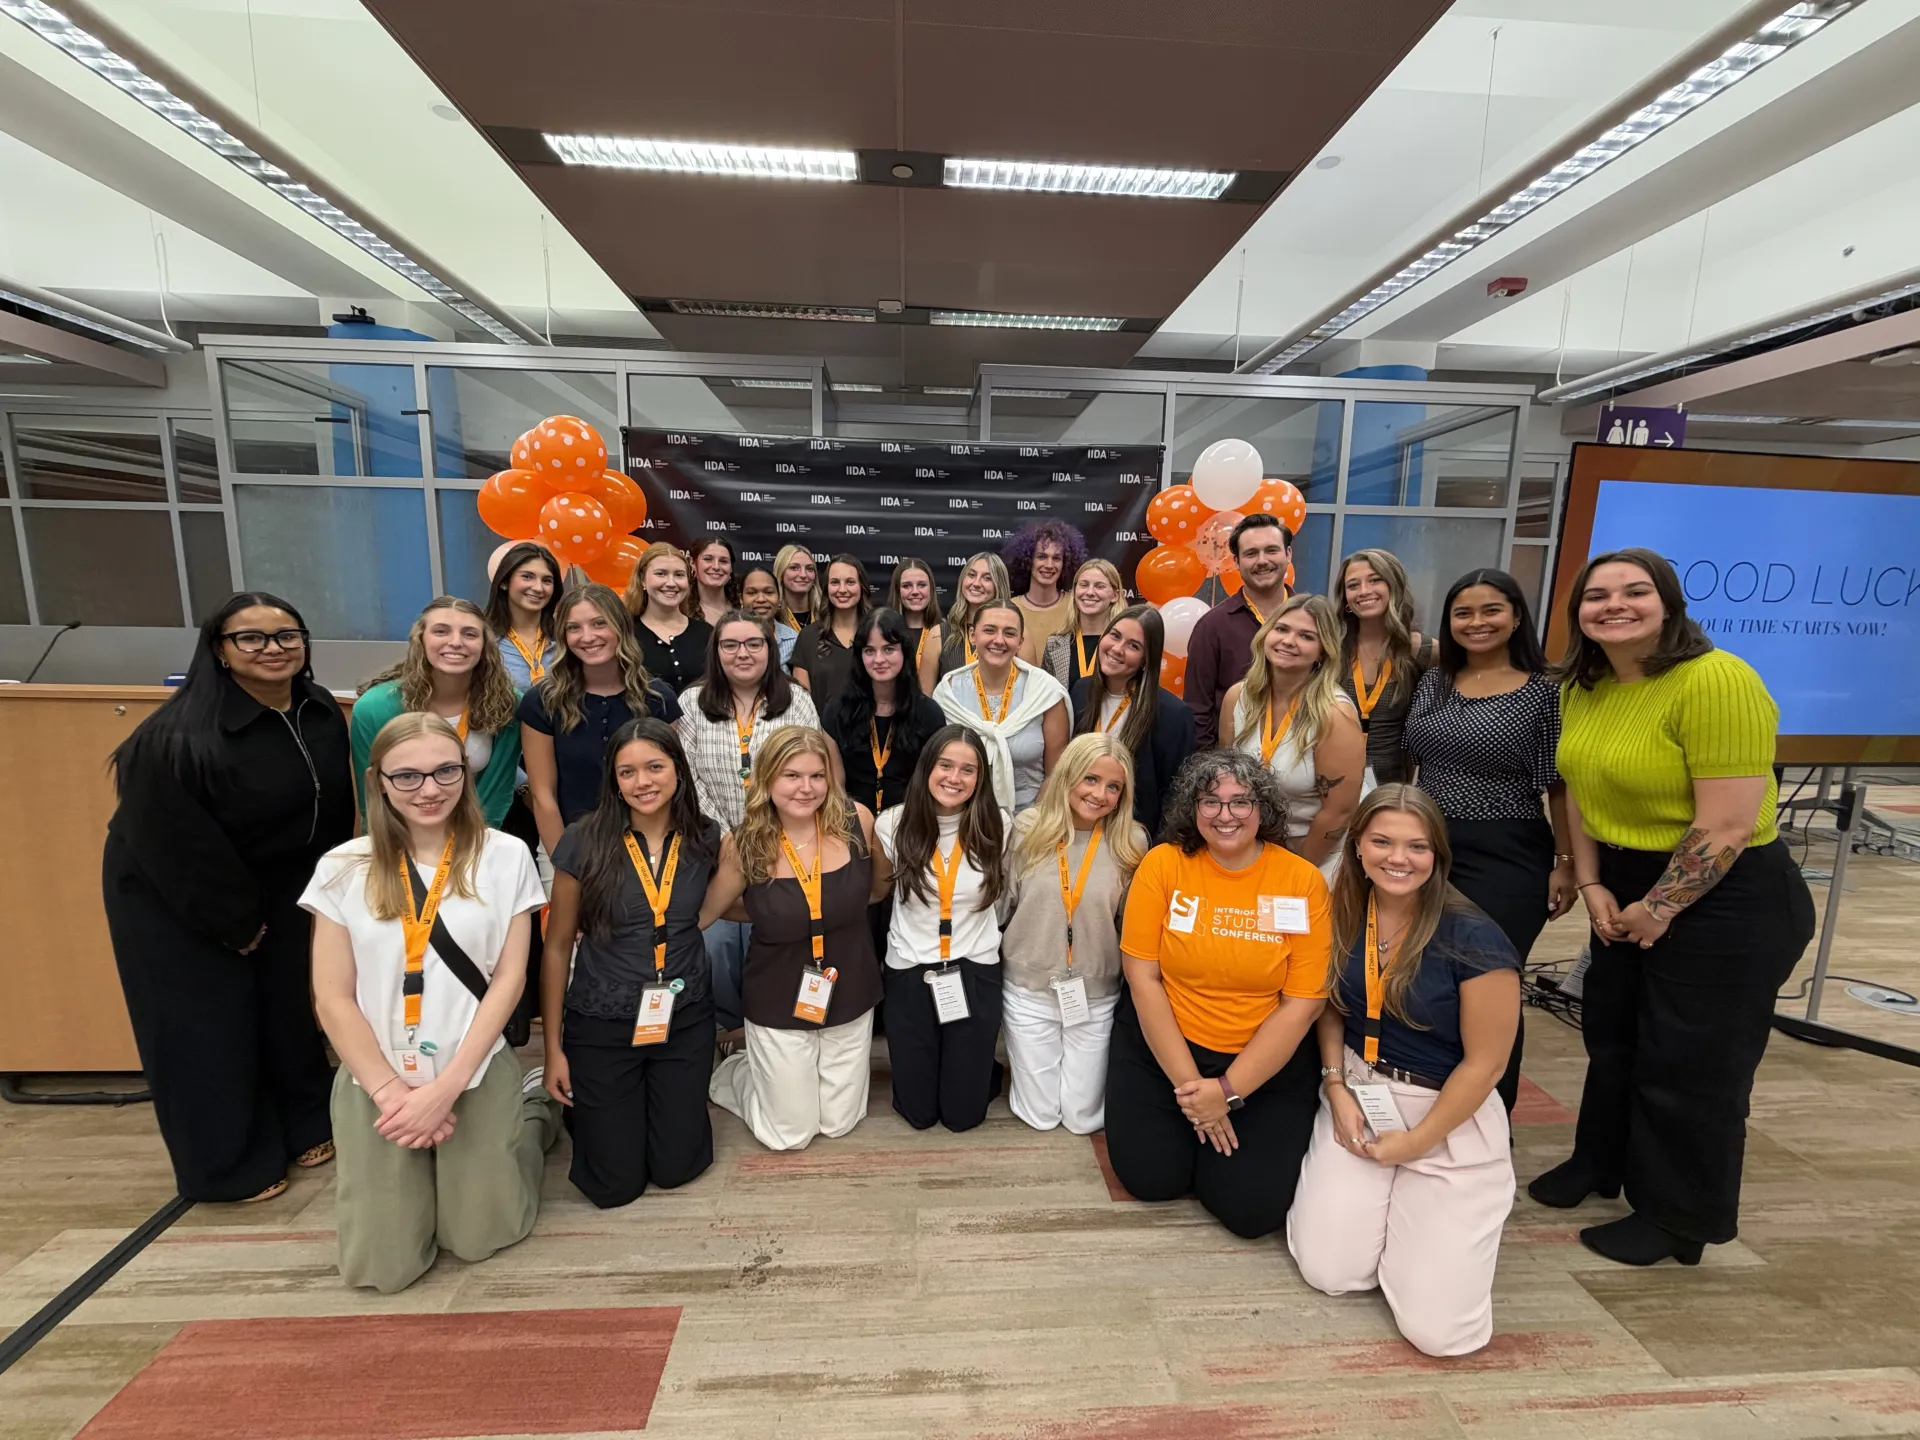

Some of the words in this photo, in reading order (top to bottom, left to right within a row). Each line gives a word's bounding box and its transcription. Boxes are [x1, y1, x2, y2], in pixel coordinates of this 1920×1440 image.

[667, 434, 688, 445] IIDA
[739, 437, 760, 448] IIDA
[810, 440, 831, 451] IIDA
[880, 442, 901, 453] IIDA
[950, 445, 971, 455] IIDA
[1019, 447, 1040, 457] IIDA
[1087, 449, 1107, 460] IIDA
[628, 457, 652, 468] IIDA
[704, 460, 725, 471] IIDA
[775, 463, 796, 474] IIDA
[846, 465, 866, 476] IIDA
[915, 467, 935, 478] IIDA
[984, 470, 1004, 480] IIDA
[1052, 472, 1072, 482] IIDA
[1119, 473, 1141, 484] IIDA
[669, 489, 690, 500] IIDA
[740, 491, 761, 502] IIDA
[811, 494, 831, 505] IIDA
[880, 496, 901, 507] IIDA
[949, 498, 969, 509] IIDA
[1017, 500, 1037, 511] IIDA
[1084, 502, 1104, 512] IIDA
[706, 520, 726, 531] IIDA
[776, 522, 797, 533] IIDA
[845, 524, 866, 535] IIDA
[914, 526, 934, 537] IIDA
[982, 528, 1002, 539] IIDA
[1115, 531, 1138, 542] IIDA
[742, 551, 763, 561] IIDA
[880, 554, 900, 565] IIDA
[948, 556, 967, 566] IIDA
[1666, 559, 1795, 603] OOD
[1699, 618, 1733, 633] OUR
[1738, 619, 1778, 634] TIME
[1780, 620, 1841, 636] STARTS
[1844, 621, 1887, 637] NOW!
[1211, 927, 1285, 944] CONFERENC
